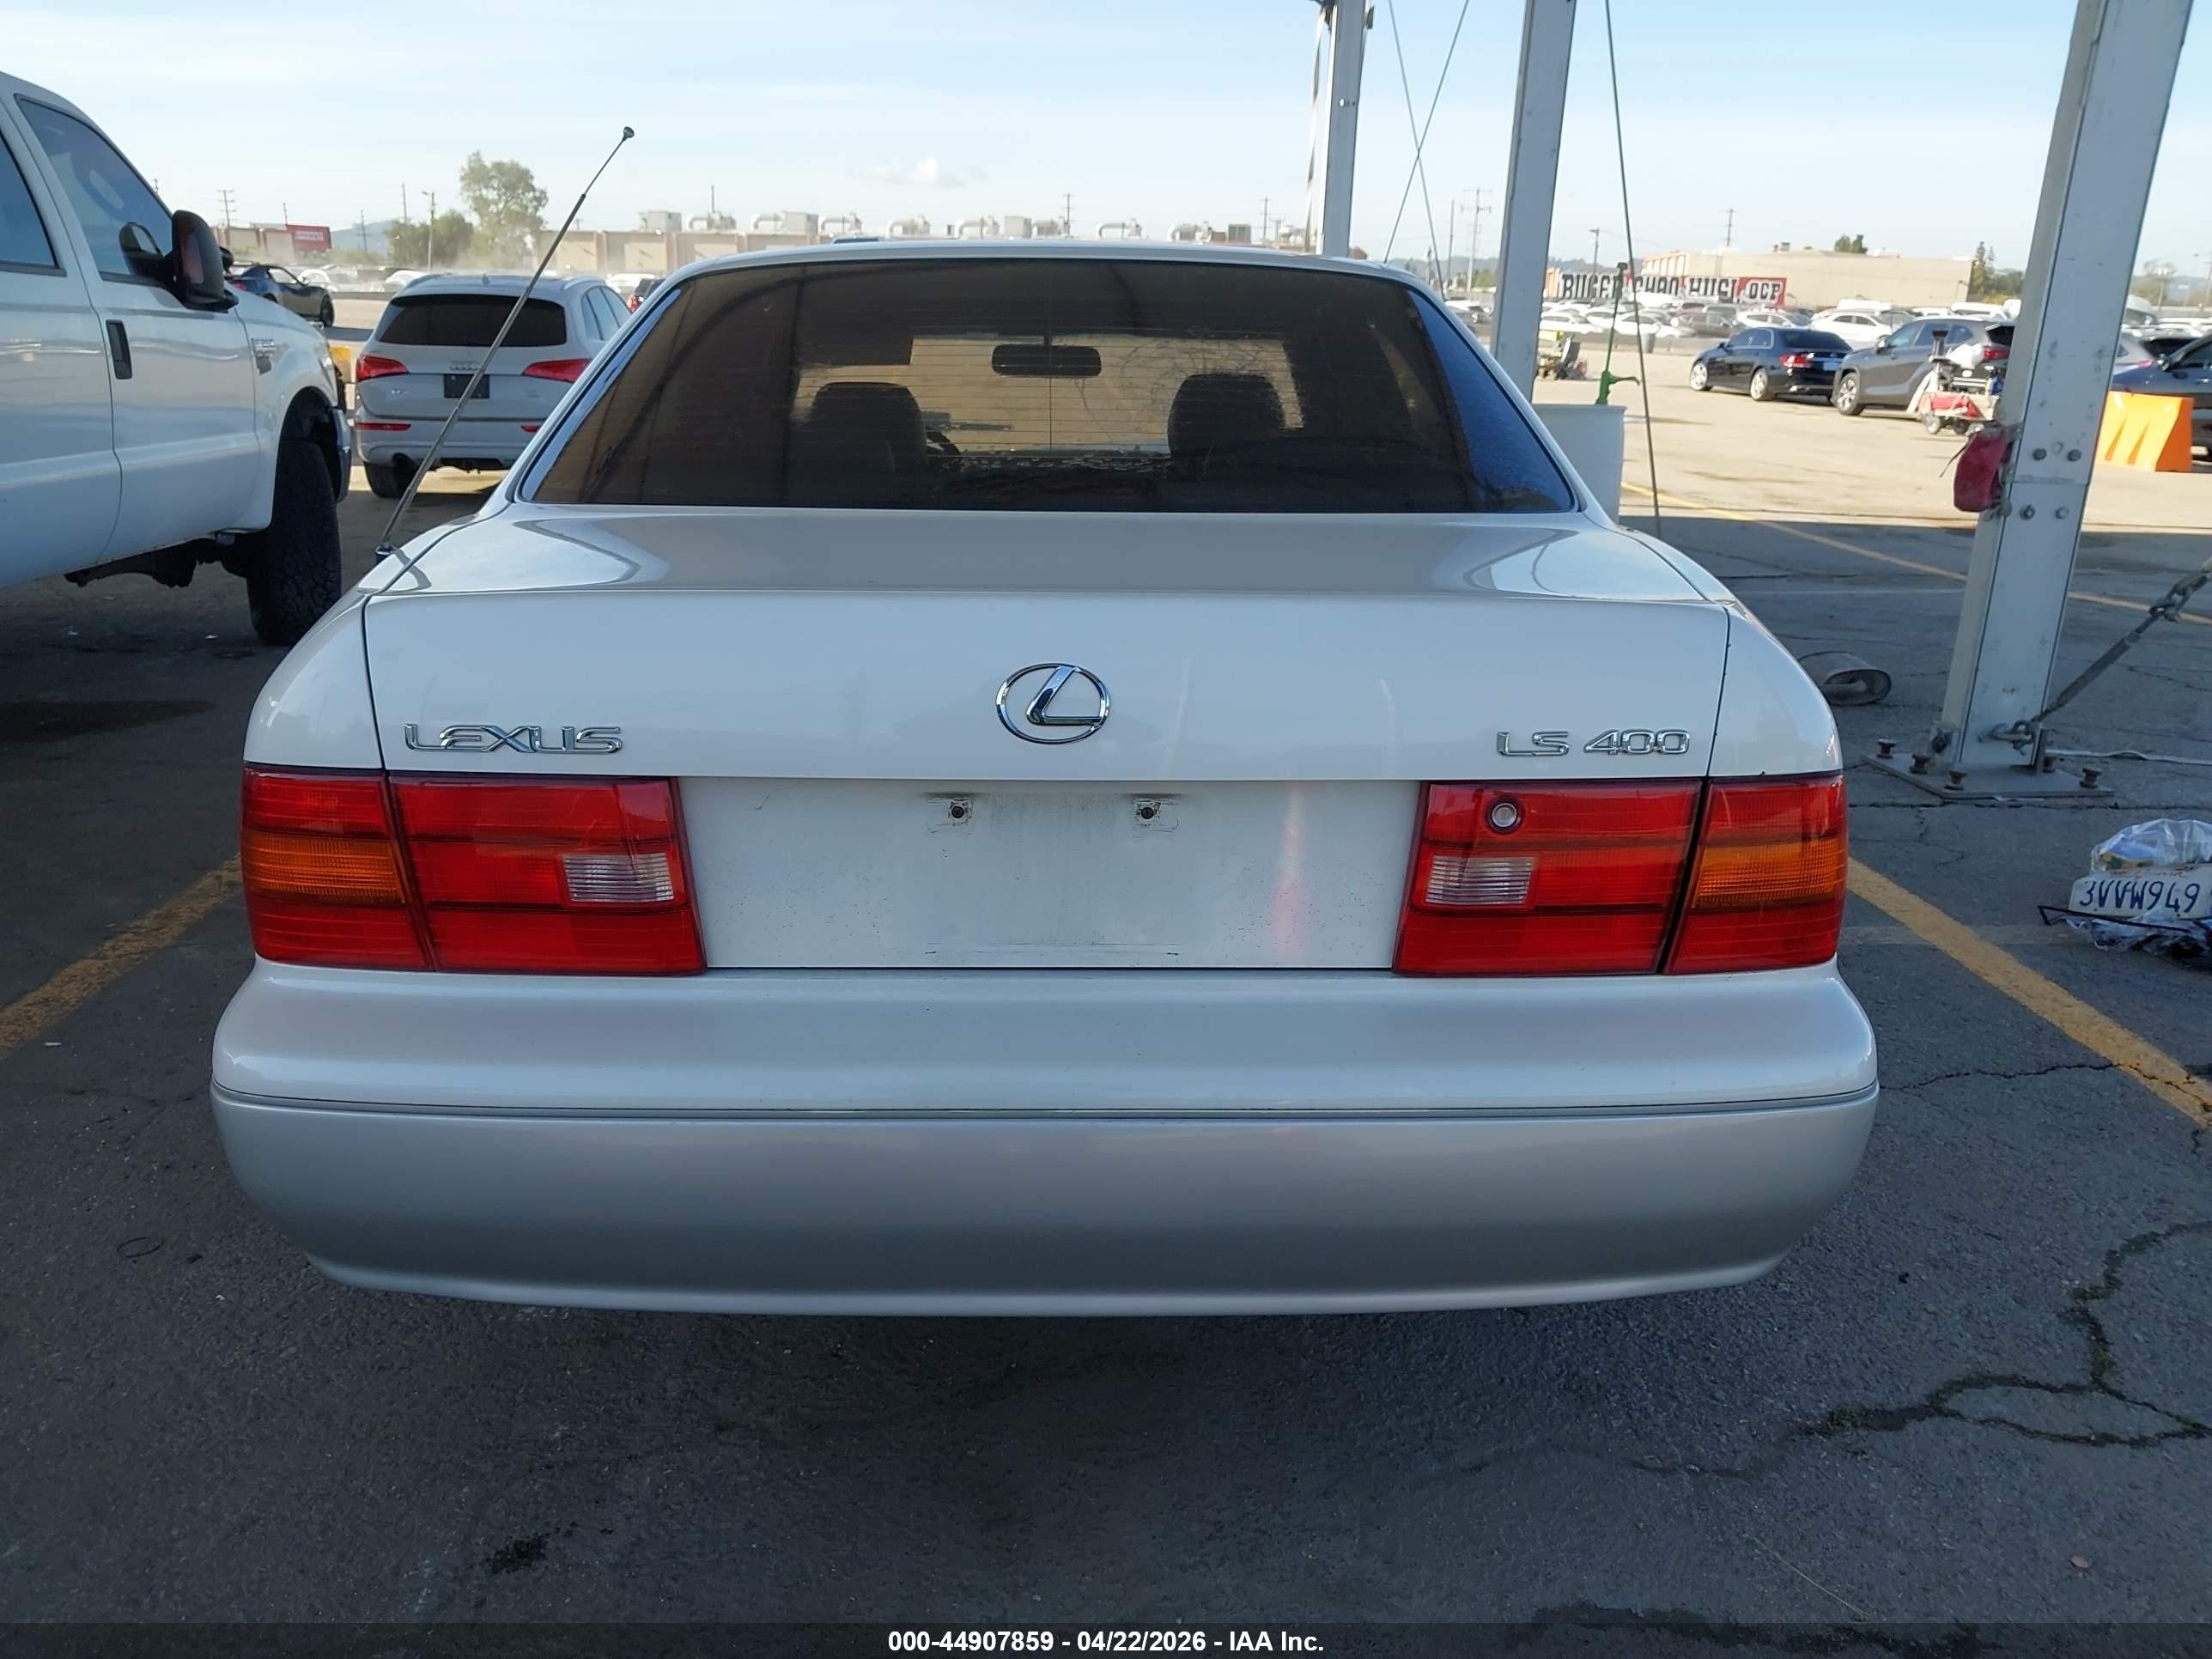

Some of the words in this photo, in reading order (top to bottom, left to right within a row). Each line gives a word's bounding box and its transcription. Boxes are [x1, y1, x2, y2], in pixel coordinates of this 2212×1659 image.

[404, 723, 623, 755] LEXUS
[1496, 731, 1571, 757] LS
[1583, 729, 1691, 756] 400
